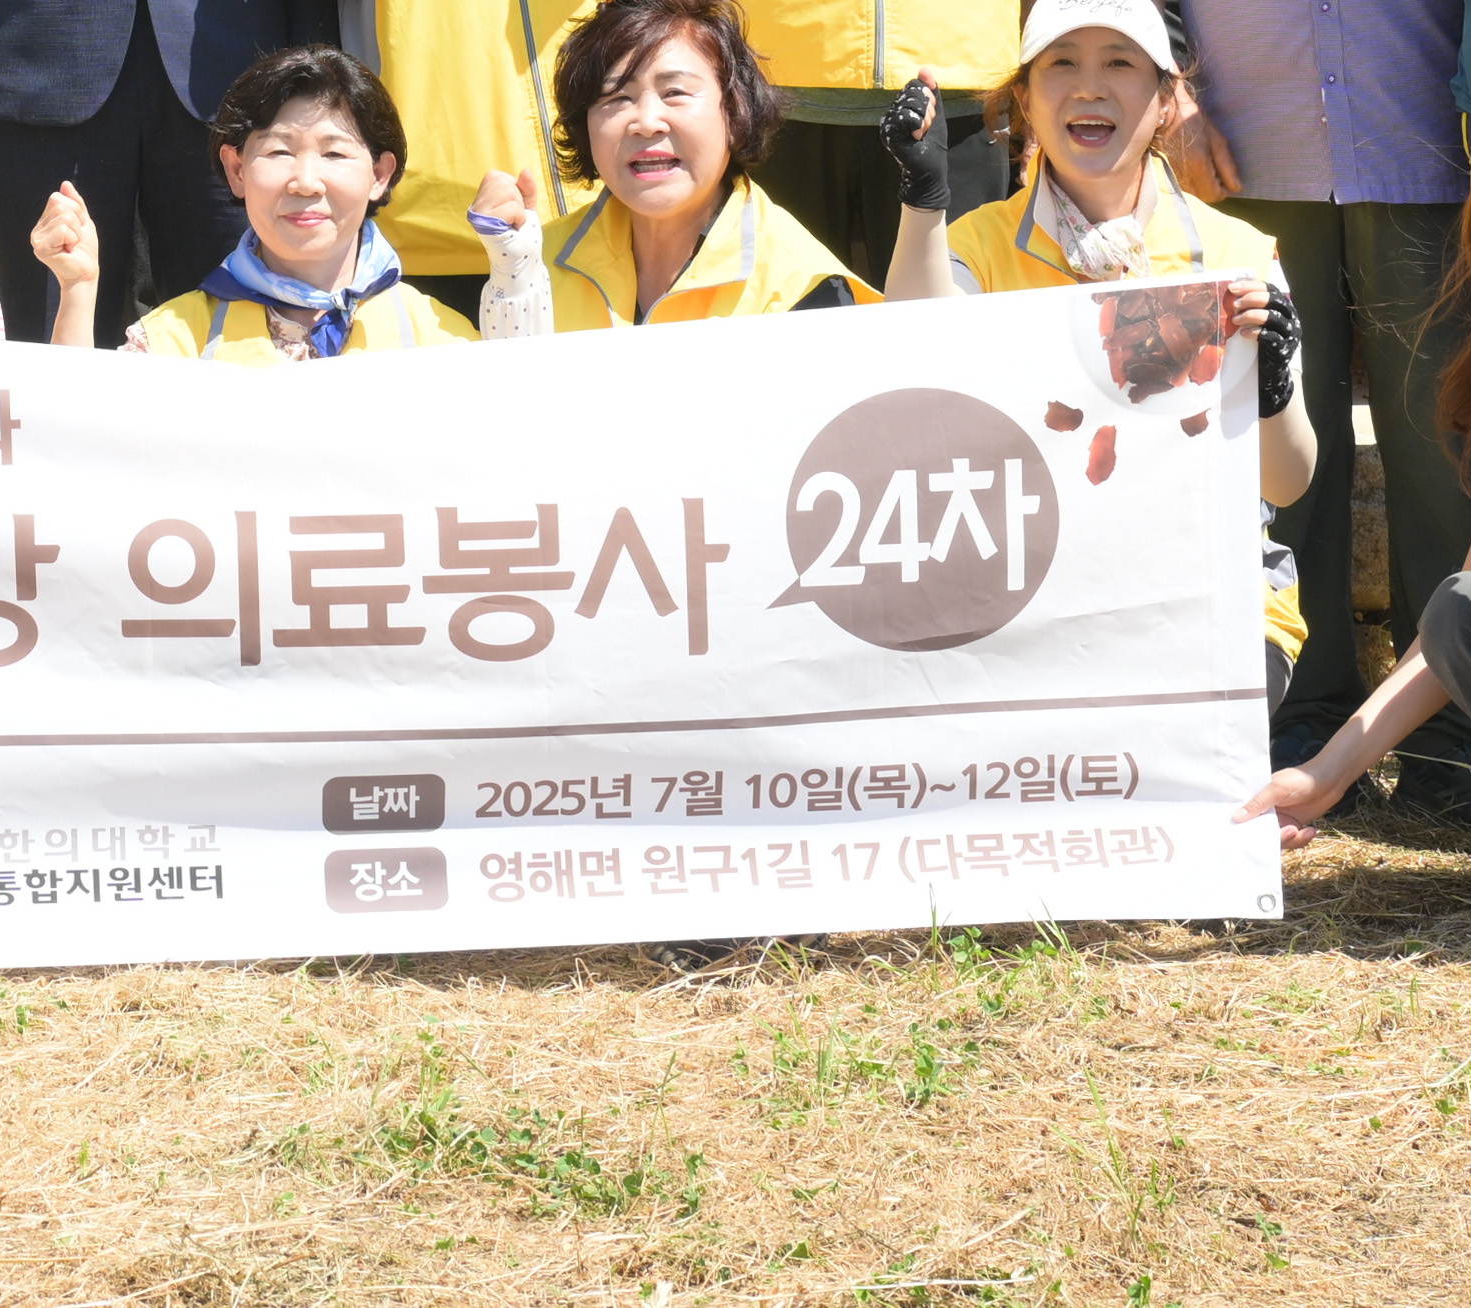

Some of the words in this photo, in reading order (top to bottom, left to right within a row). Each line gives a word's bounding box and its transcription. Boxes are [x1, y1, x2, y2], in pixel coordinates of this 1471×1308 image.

[796, 457, 1041, 592] 24차
[121, 497, 731, 667] 의료봉사
[348, 784, 421, 821] 날짜
[475, 772, 633, 820] 2025년
[650, 770, 725, 817] 7월
[349, 860, 424, 902] 장소
[479, 847, 625, 903] 영해면
[640, 839, 814, 895] 원구1길
[830, 840, 881, 882] 17
[898, 825, 1175, 883] (다목적회관)
